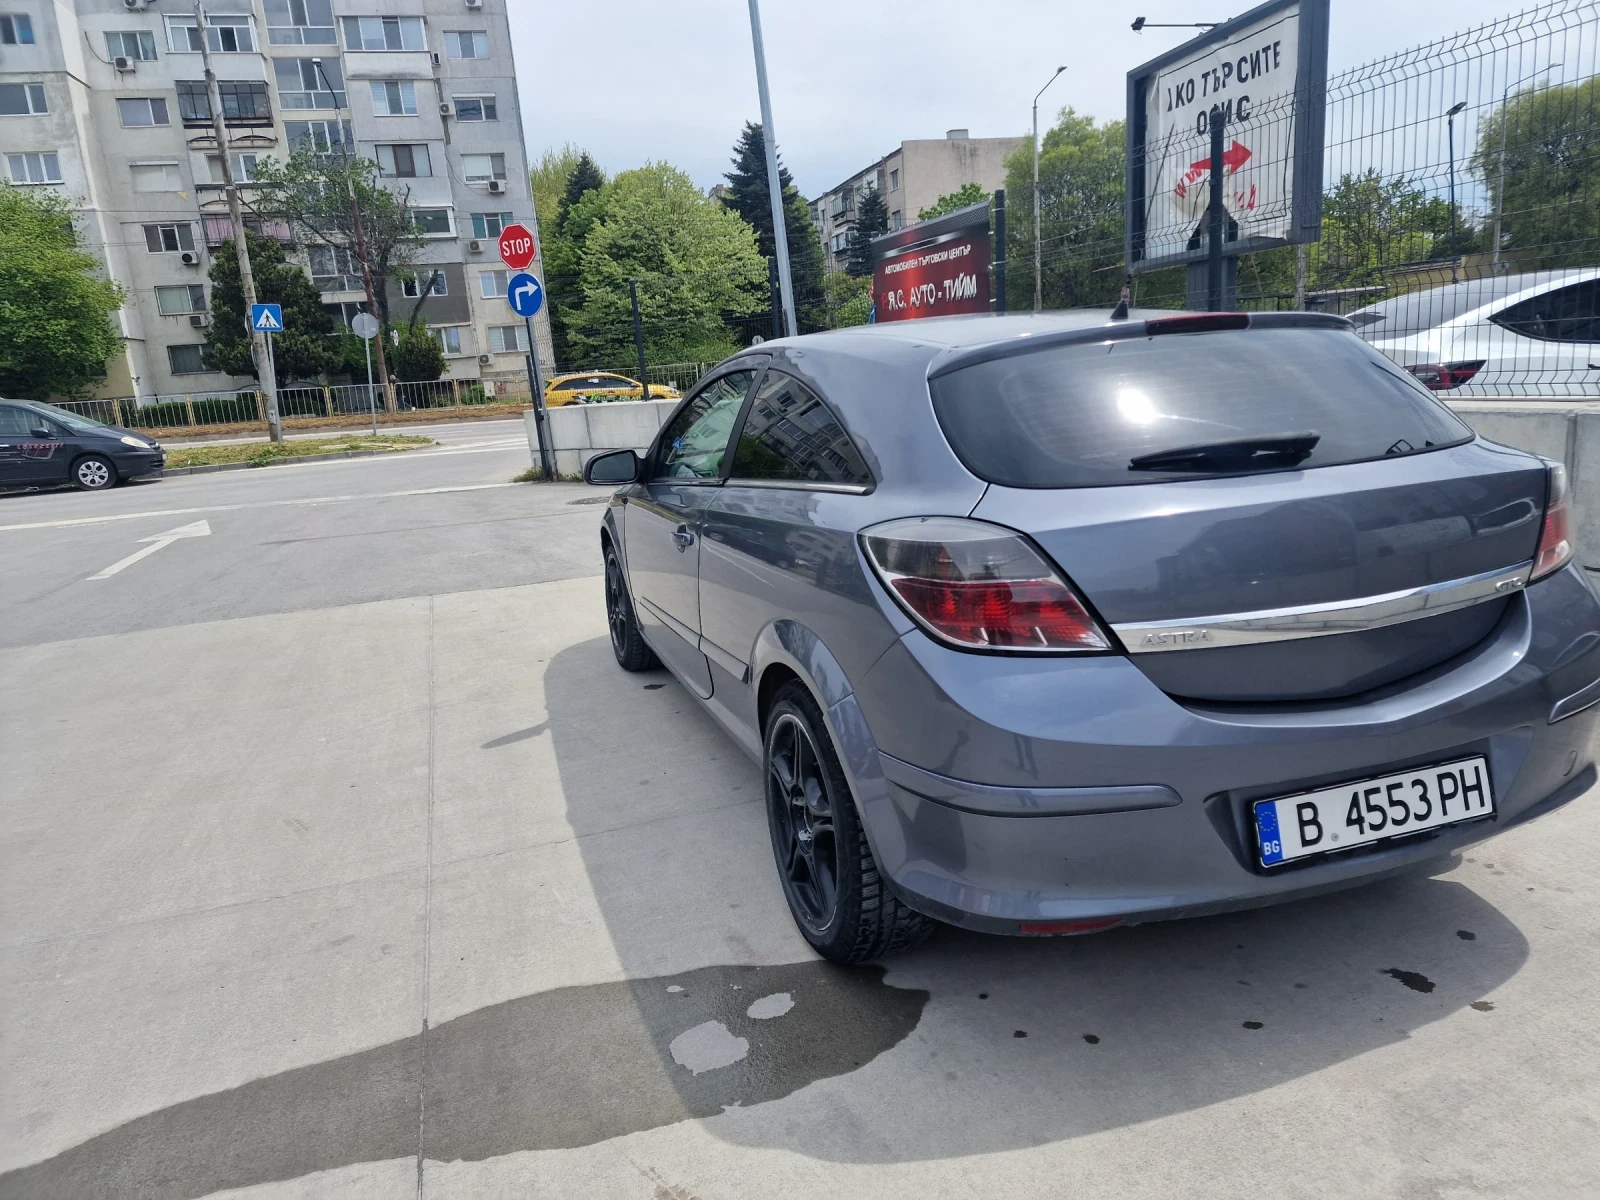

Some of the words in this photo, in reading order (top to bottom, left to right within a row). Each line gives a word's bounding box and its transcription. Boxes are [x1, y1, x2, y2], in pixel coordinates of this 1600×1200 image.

[1201, 40, 1281, 98] ТЪРСИТЕ
[502, 238, 531, 256] STOP
[884, 258, 918, 275] АВТОМОБИЛЕН
[918, 250, 949, 267] ТЪРГОВСКИ
[948, 244, 972, 260] ЦЕНТЪР
[910, 283, 936, 307] АУТО
[943, 272, 977, 301] ТИЙМ
[1141, 629, 1209, 646] ASTRA
[1296, 801, 1324, 848] B
[1346, 778, 1432, 835] 4553
[1436, 765, 1486, 817] PH
[1263, 840, 1280, 856] BG
